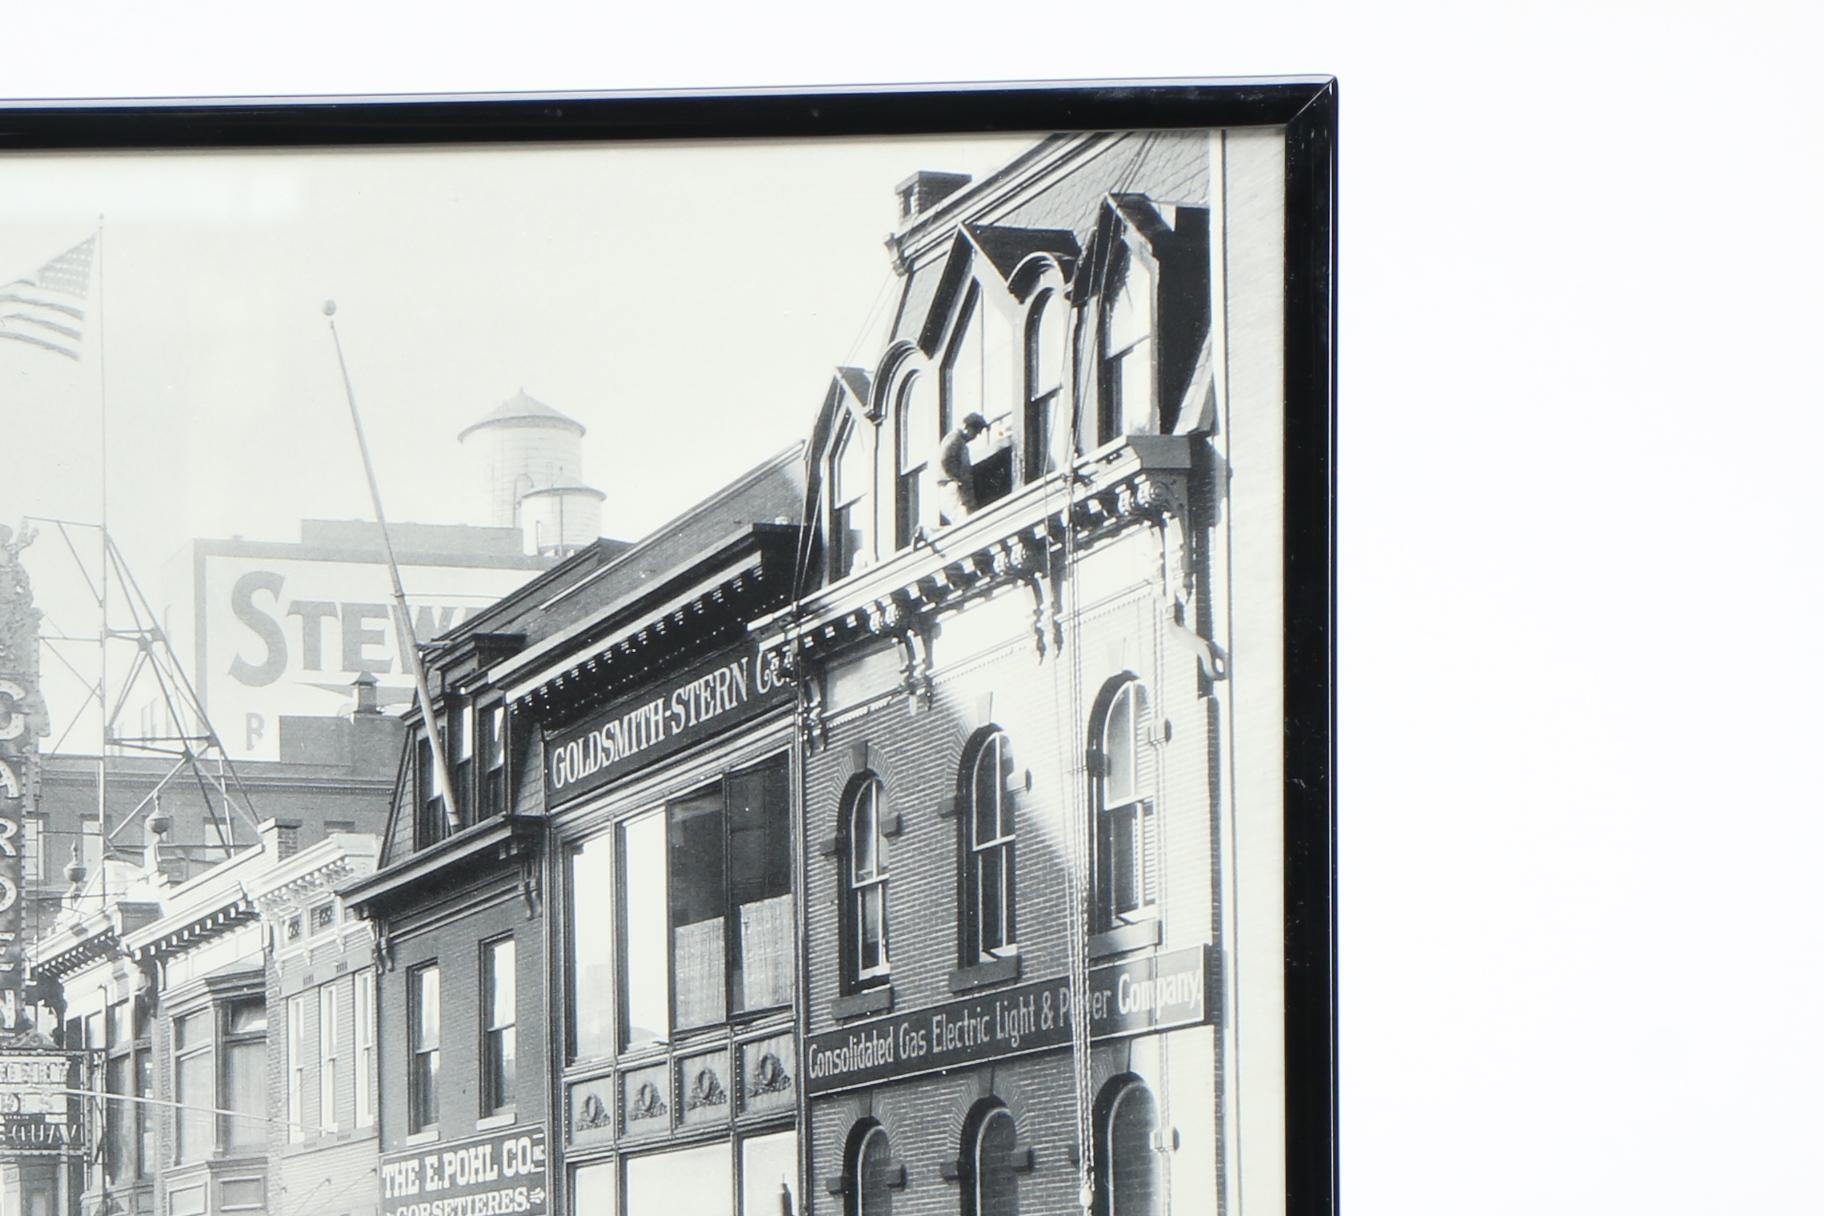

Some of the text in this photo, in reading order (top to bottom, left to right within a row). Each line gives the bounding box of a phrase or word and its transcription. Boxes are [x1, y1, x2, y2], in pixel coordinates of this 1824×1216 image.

[552, 656, 750, 789] GOLDSMITH-STERN
[809, 1026, 894, 1079] Consolidated
[899, 1022, 927, 1059] Gas
[932, 1007, 991, 1054] Electric
[996, 994, 1036, 1048] Light
[1041, 990, 1054, 1031] &
[1059, 985, 1112, 1027] Per
[382, 1159, 420, 1199] THE
